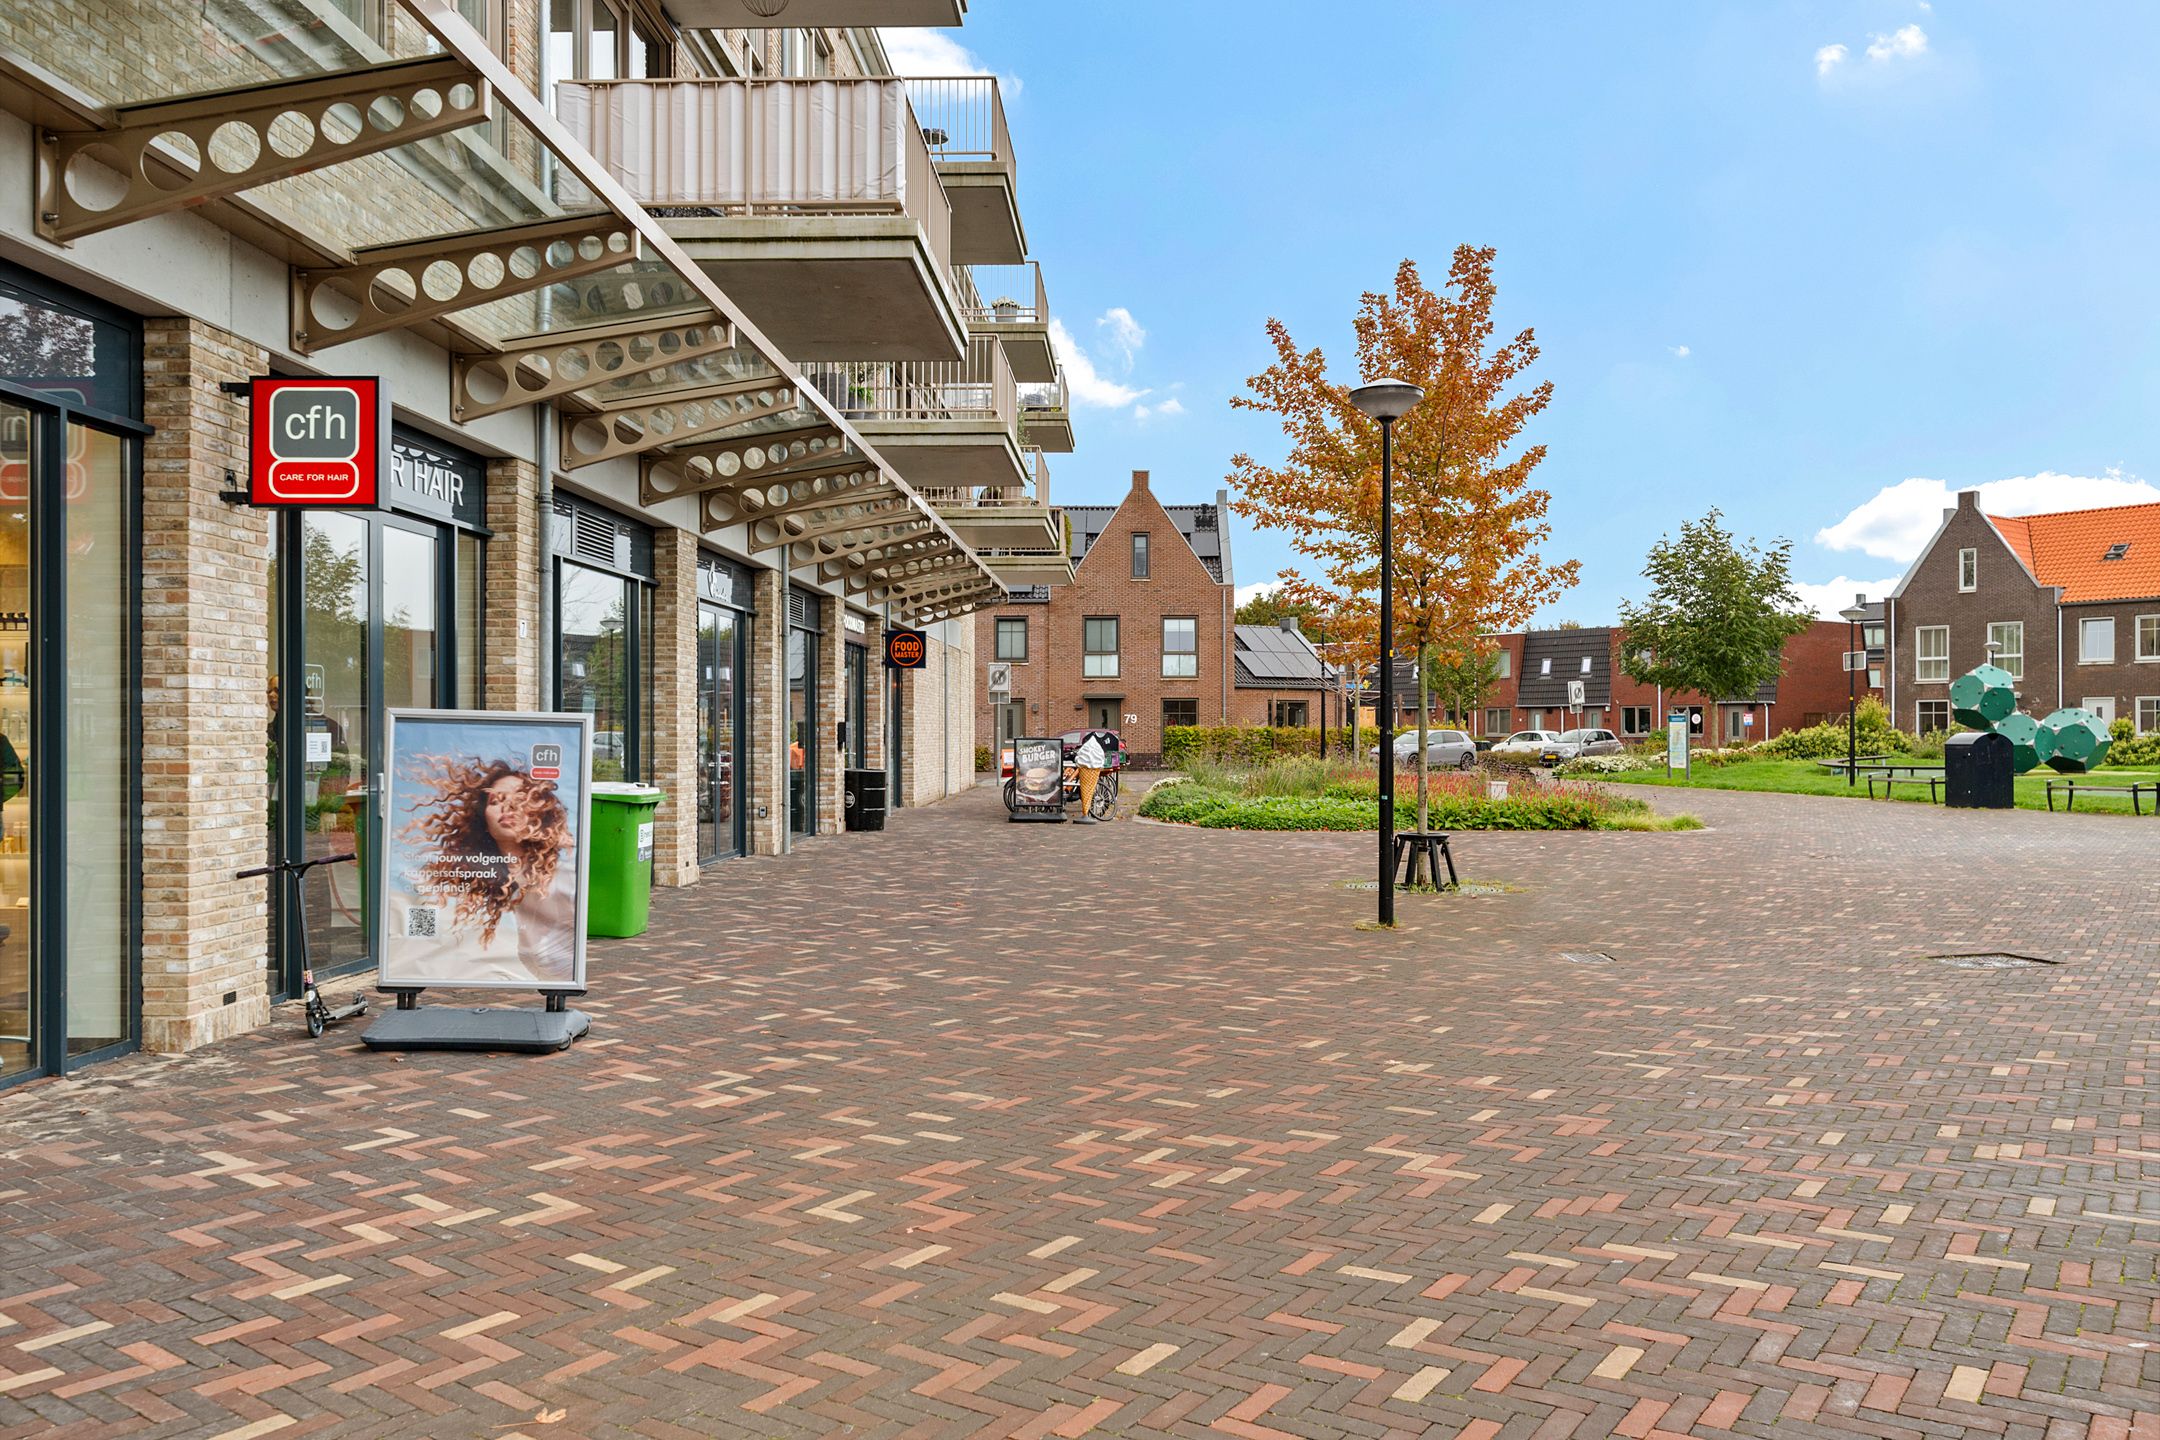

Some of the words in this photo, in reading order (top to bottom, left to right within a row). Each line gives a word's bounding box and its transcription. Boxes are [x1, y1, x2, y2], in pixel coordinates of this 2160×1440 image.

[285, 405, 346, 440] cfh
[279, 473, 304, 482] CARE
[306, 473, 325, 482] FOR
[327, 473, 349, 482] HAIR
[413, 458, 464, 507] HAIR
[843, 613, 866, 634] OODMASTER
[894, 641, 920, 652] FOOD
[305, 672, 322, 689] cfh
[1124, 714, 1138, 724] 79
[536, 749, 558, 762] cfh
[1018, 744, 1046, 755] SMOKEY
[1022, 749, 1056, 763] BURGER
[434, 853, 463, 864] jouw
[466, 852, 518, 865] volgende
[417, 881, 471, 895] gepland?
